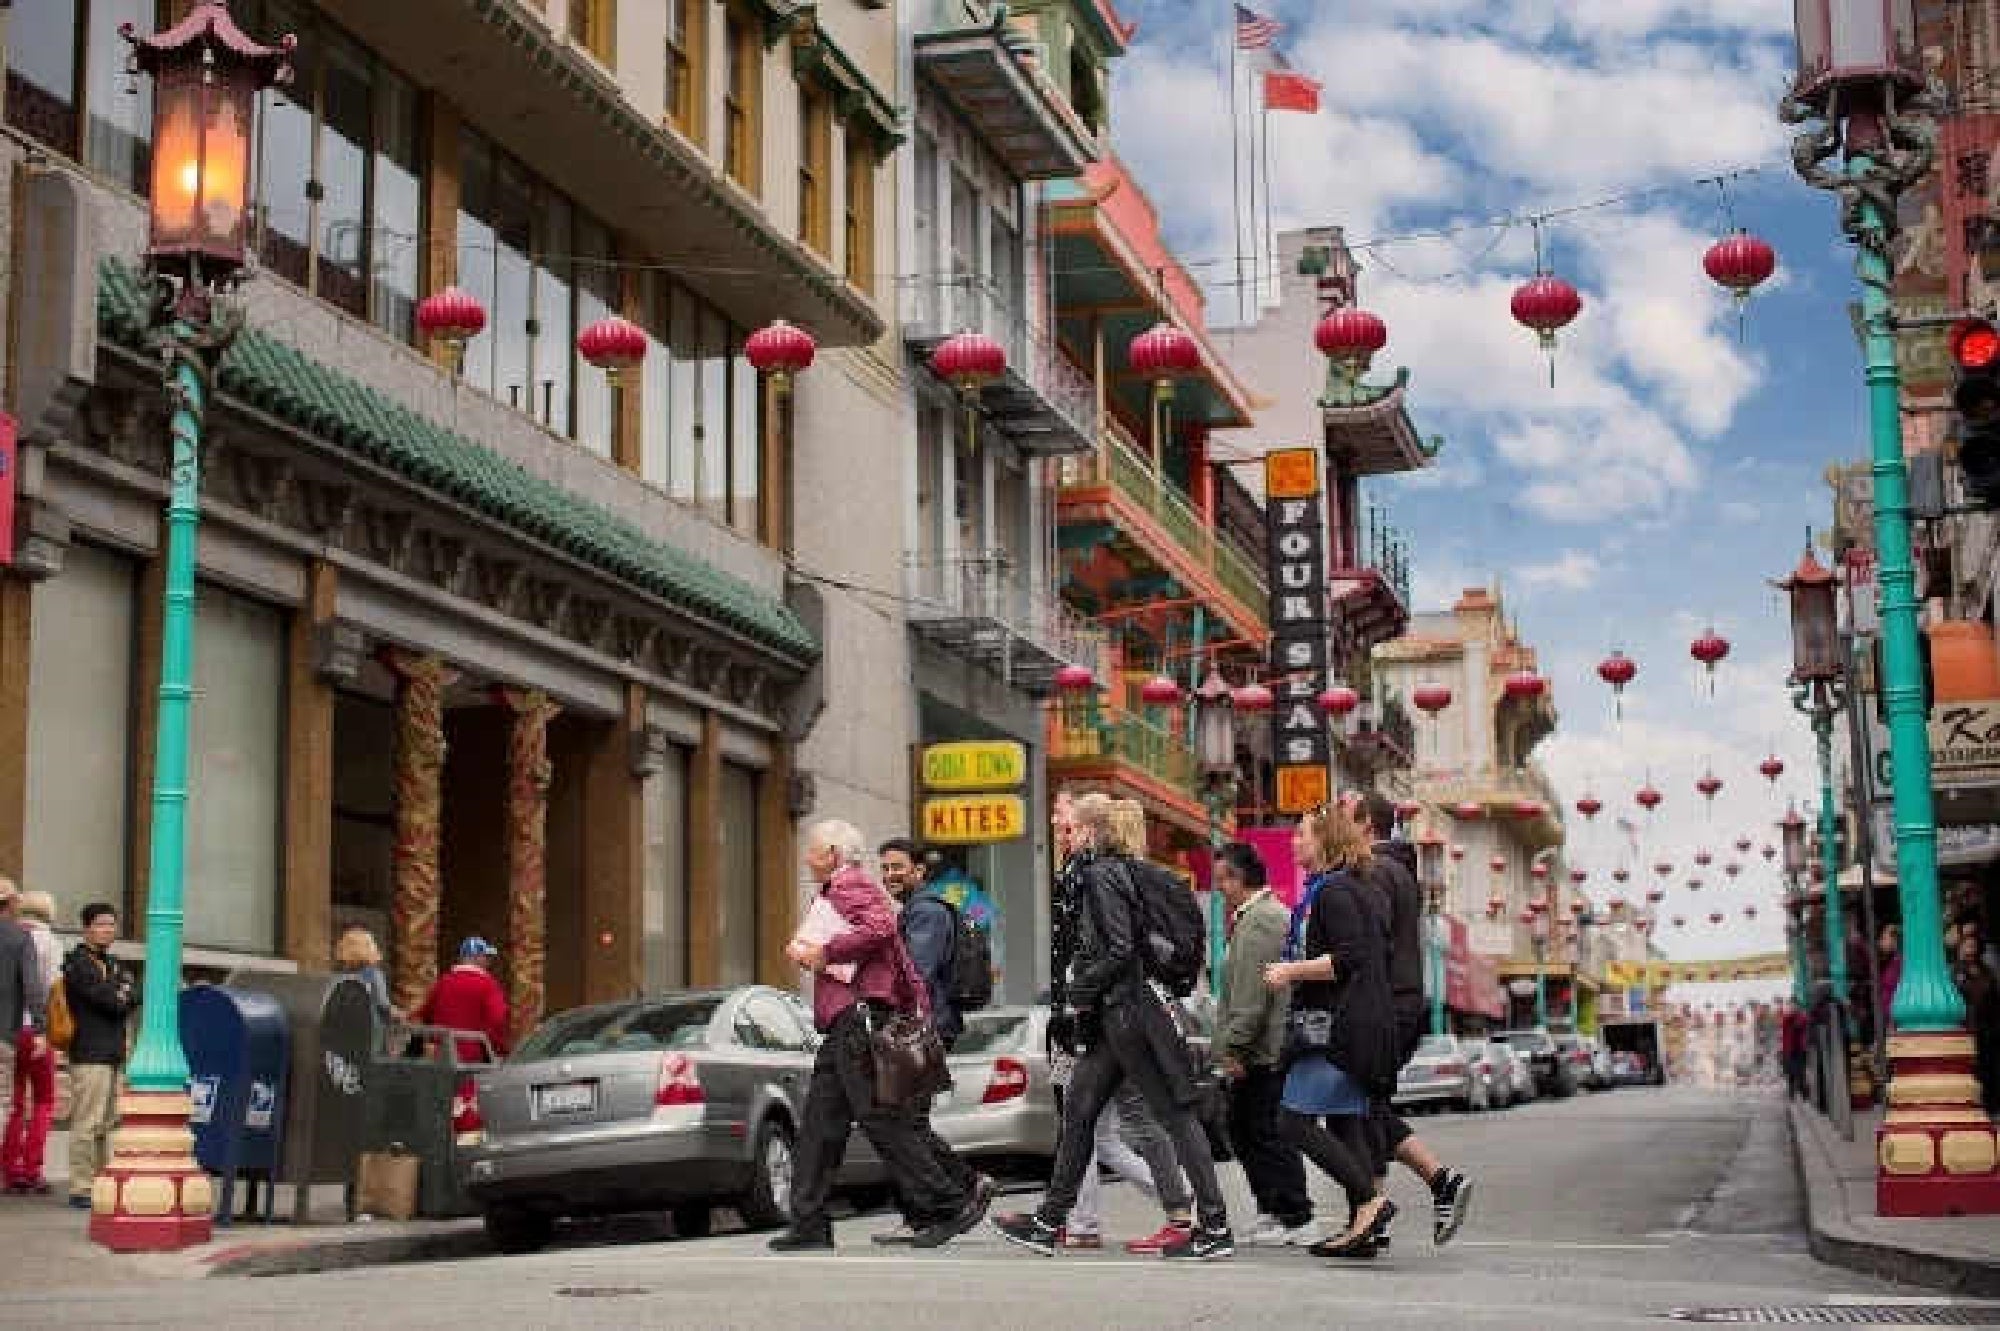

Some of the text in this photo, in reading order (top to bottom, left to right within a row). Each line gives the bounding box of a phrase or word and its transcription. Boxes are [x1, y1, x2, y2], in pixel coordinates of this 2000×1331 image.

[1280, 502, 1312, 620] FOUR
[1284, 642, 1317, 761] SEAS
[930, 804, 1011, 834] KITES
